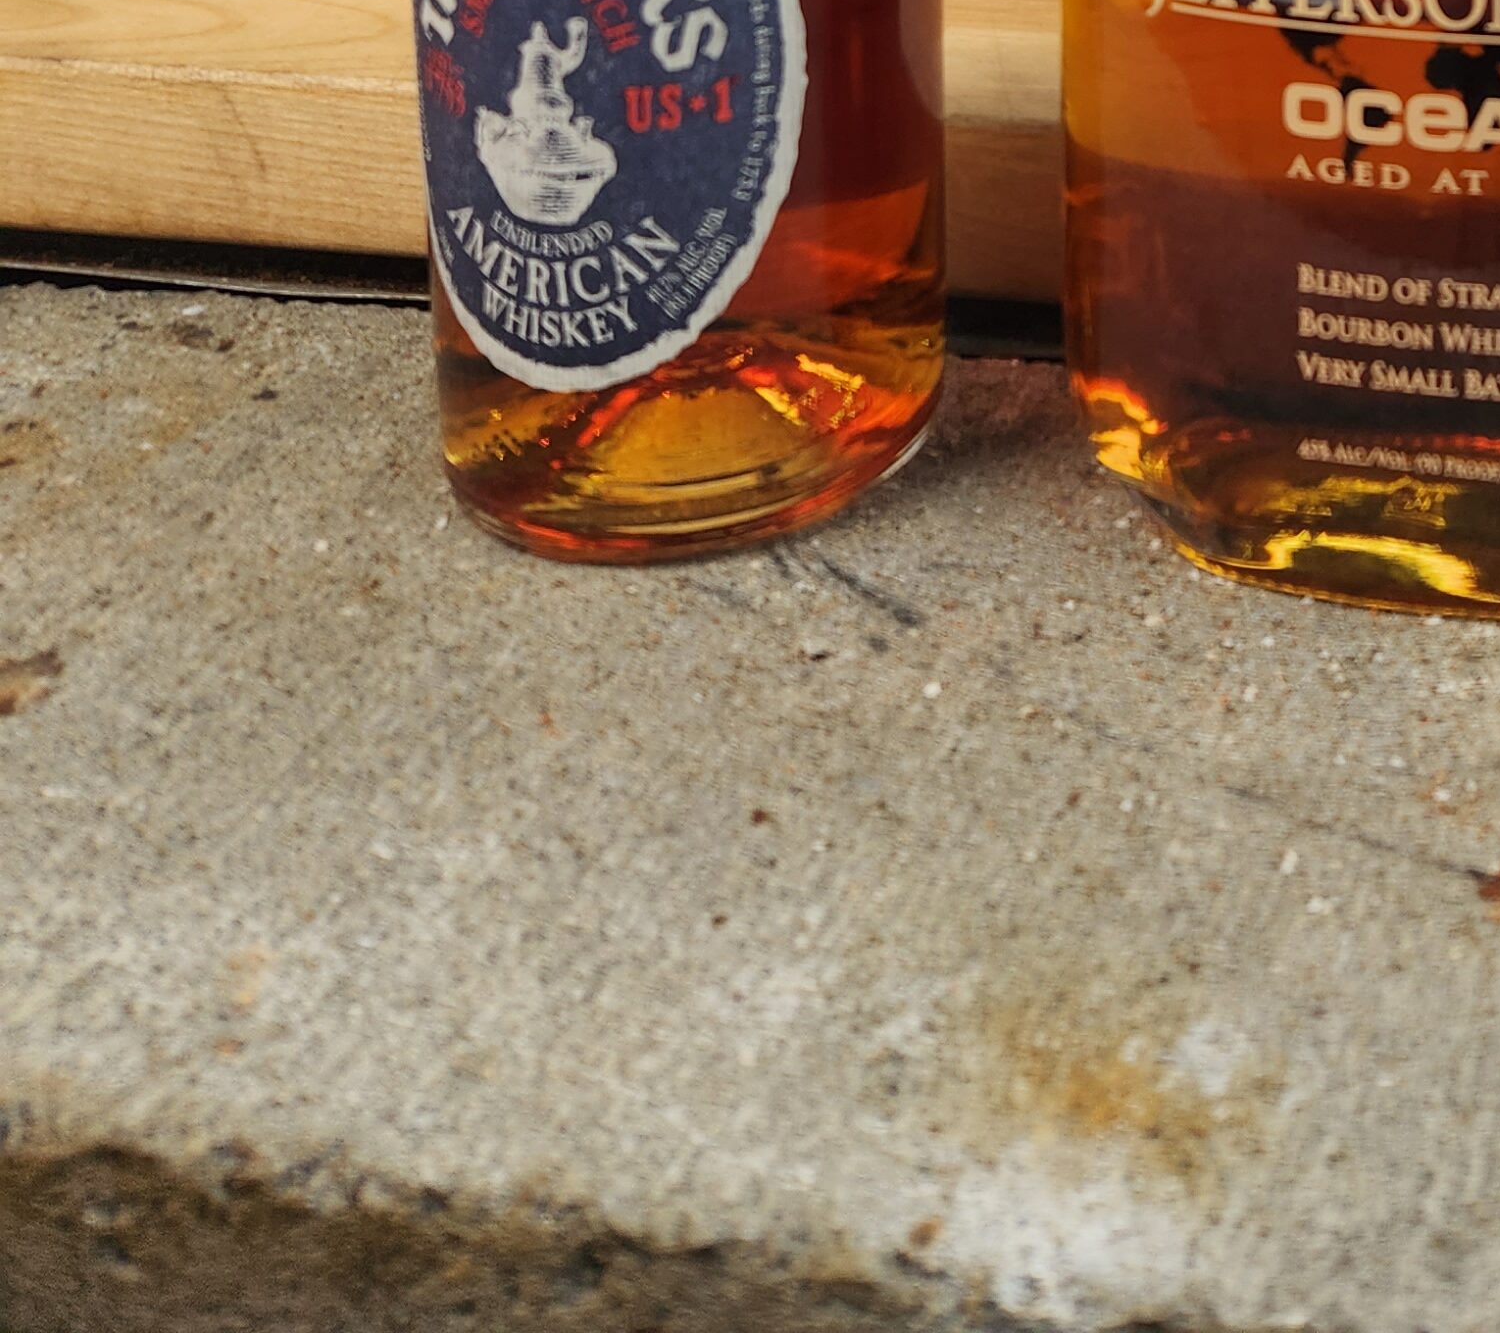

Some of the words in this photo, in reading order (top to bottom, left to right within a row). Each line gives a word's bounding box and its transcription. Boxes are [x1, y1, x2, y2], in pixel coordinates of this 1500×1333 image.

[1285, 152, 1412, 191] AGED
[1430, 166, 1491, 197] AT
[446, 205, 681, 308] AMERICAN
[1296, 261, 1390, 303] BLEND
[1391, 276, 1433, 307] OF
[481, 281, 639, 348] WHISKEY
[1297, 305, 1435, 351] BOURBON
[1296, 349, 1368, 390] VERY
[1368, 358, 1460, 399] SMALL
